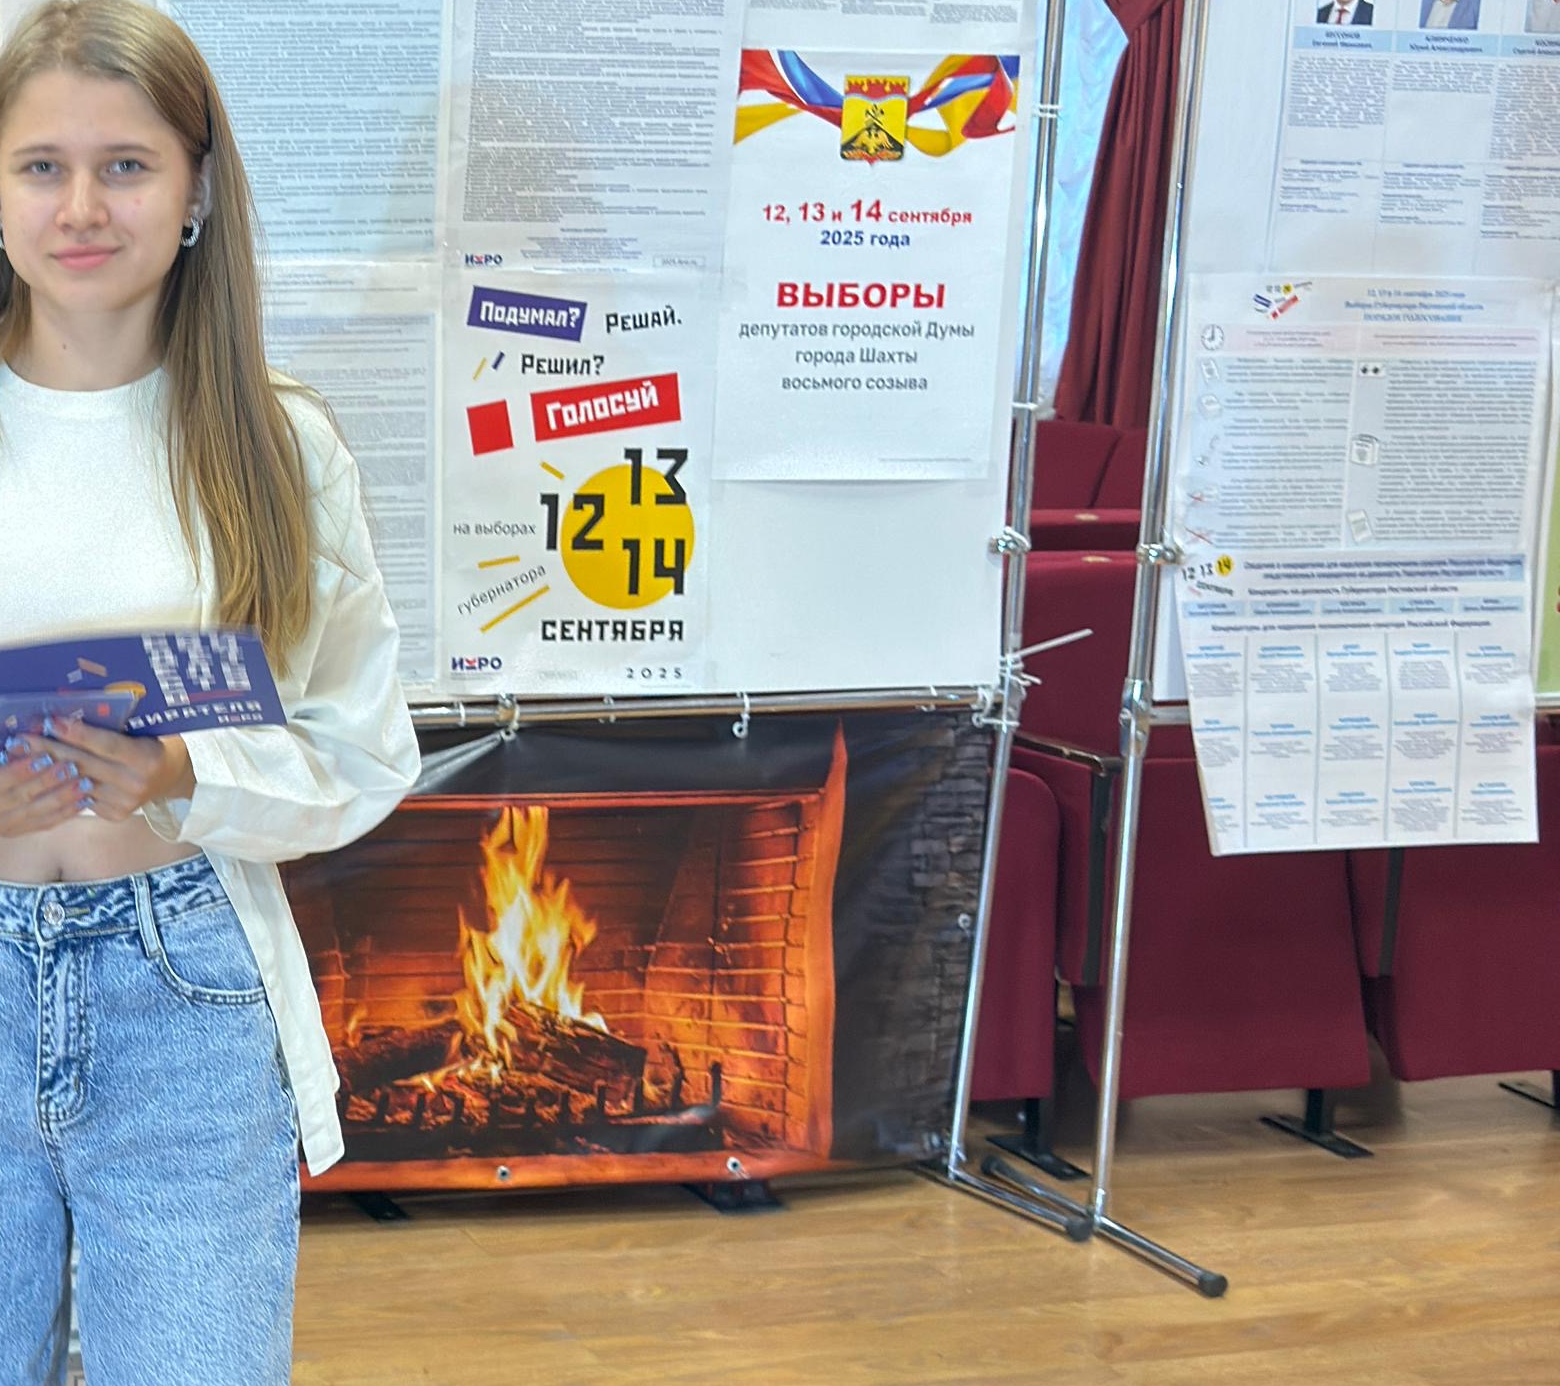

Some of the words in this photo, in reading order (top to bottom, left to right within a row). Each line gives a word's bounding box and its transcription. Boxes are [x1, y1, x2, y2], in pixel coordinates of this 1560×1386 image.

[762, 204, 791, 225] 12,
[798, 202, 825, 223] 13
[832, 210, 843, 222] и
[850, 199, 883, 223] 14
[888, 207, 973, 227] сентября
[820, 229, 864, 246] 2025
[870, 232, 911, 248] года
[776, 282, 946, 309] ВЫБОРЫ
[739, 321, 828, 339] депутатов
[832, 320, 923, 340] городской
[925, 321, 975, 339] Думы
[795, 349, 856, 367] города
[859, 348, 918, 364] Шахты
[781, 375, 862, 391] восьмого
[865, 376, 929, 391] созыва
[624, 448, 689, 506] 13
[453, 523, 471, 535] на
[474, 521, 537, 539] выборах
[540, 493, 605, 551] 12
[622, 538, 686, 596] 14
[457, 565, 547, 616] губернатора
[541, 620, 684, 642] СЕНТЯБРЯ
[625, 666, 683, 680] 2025
